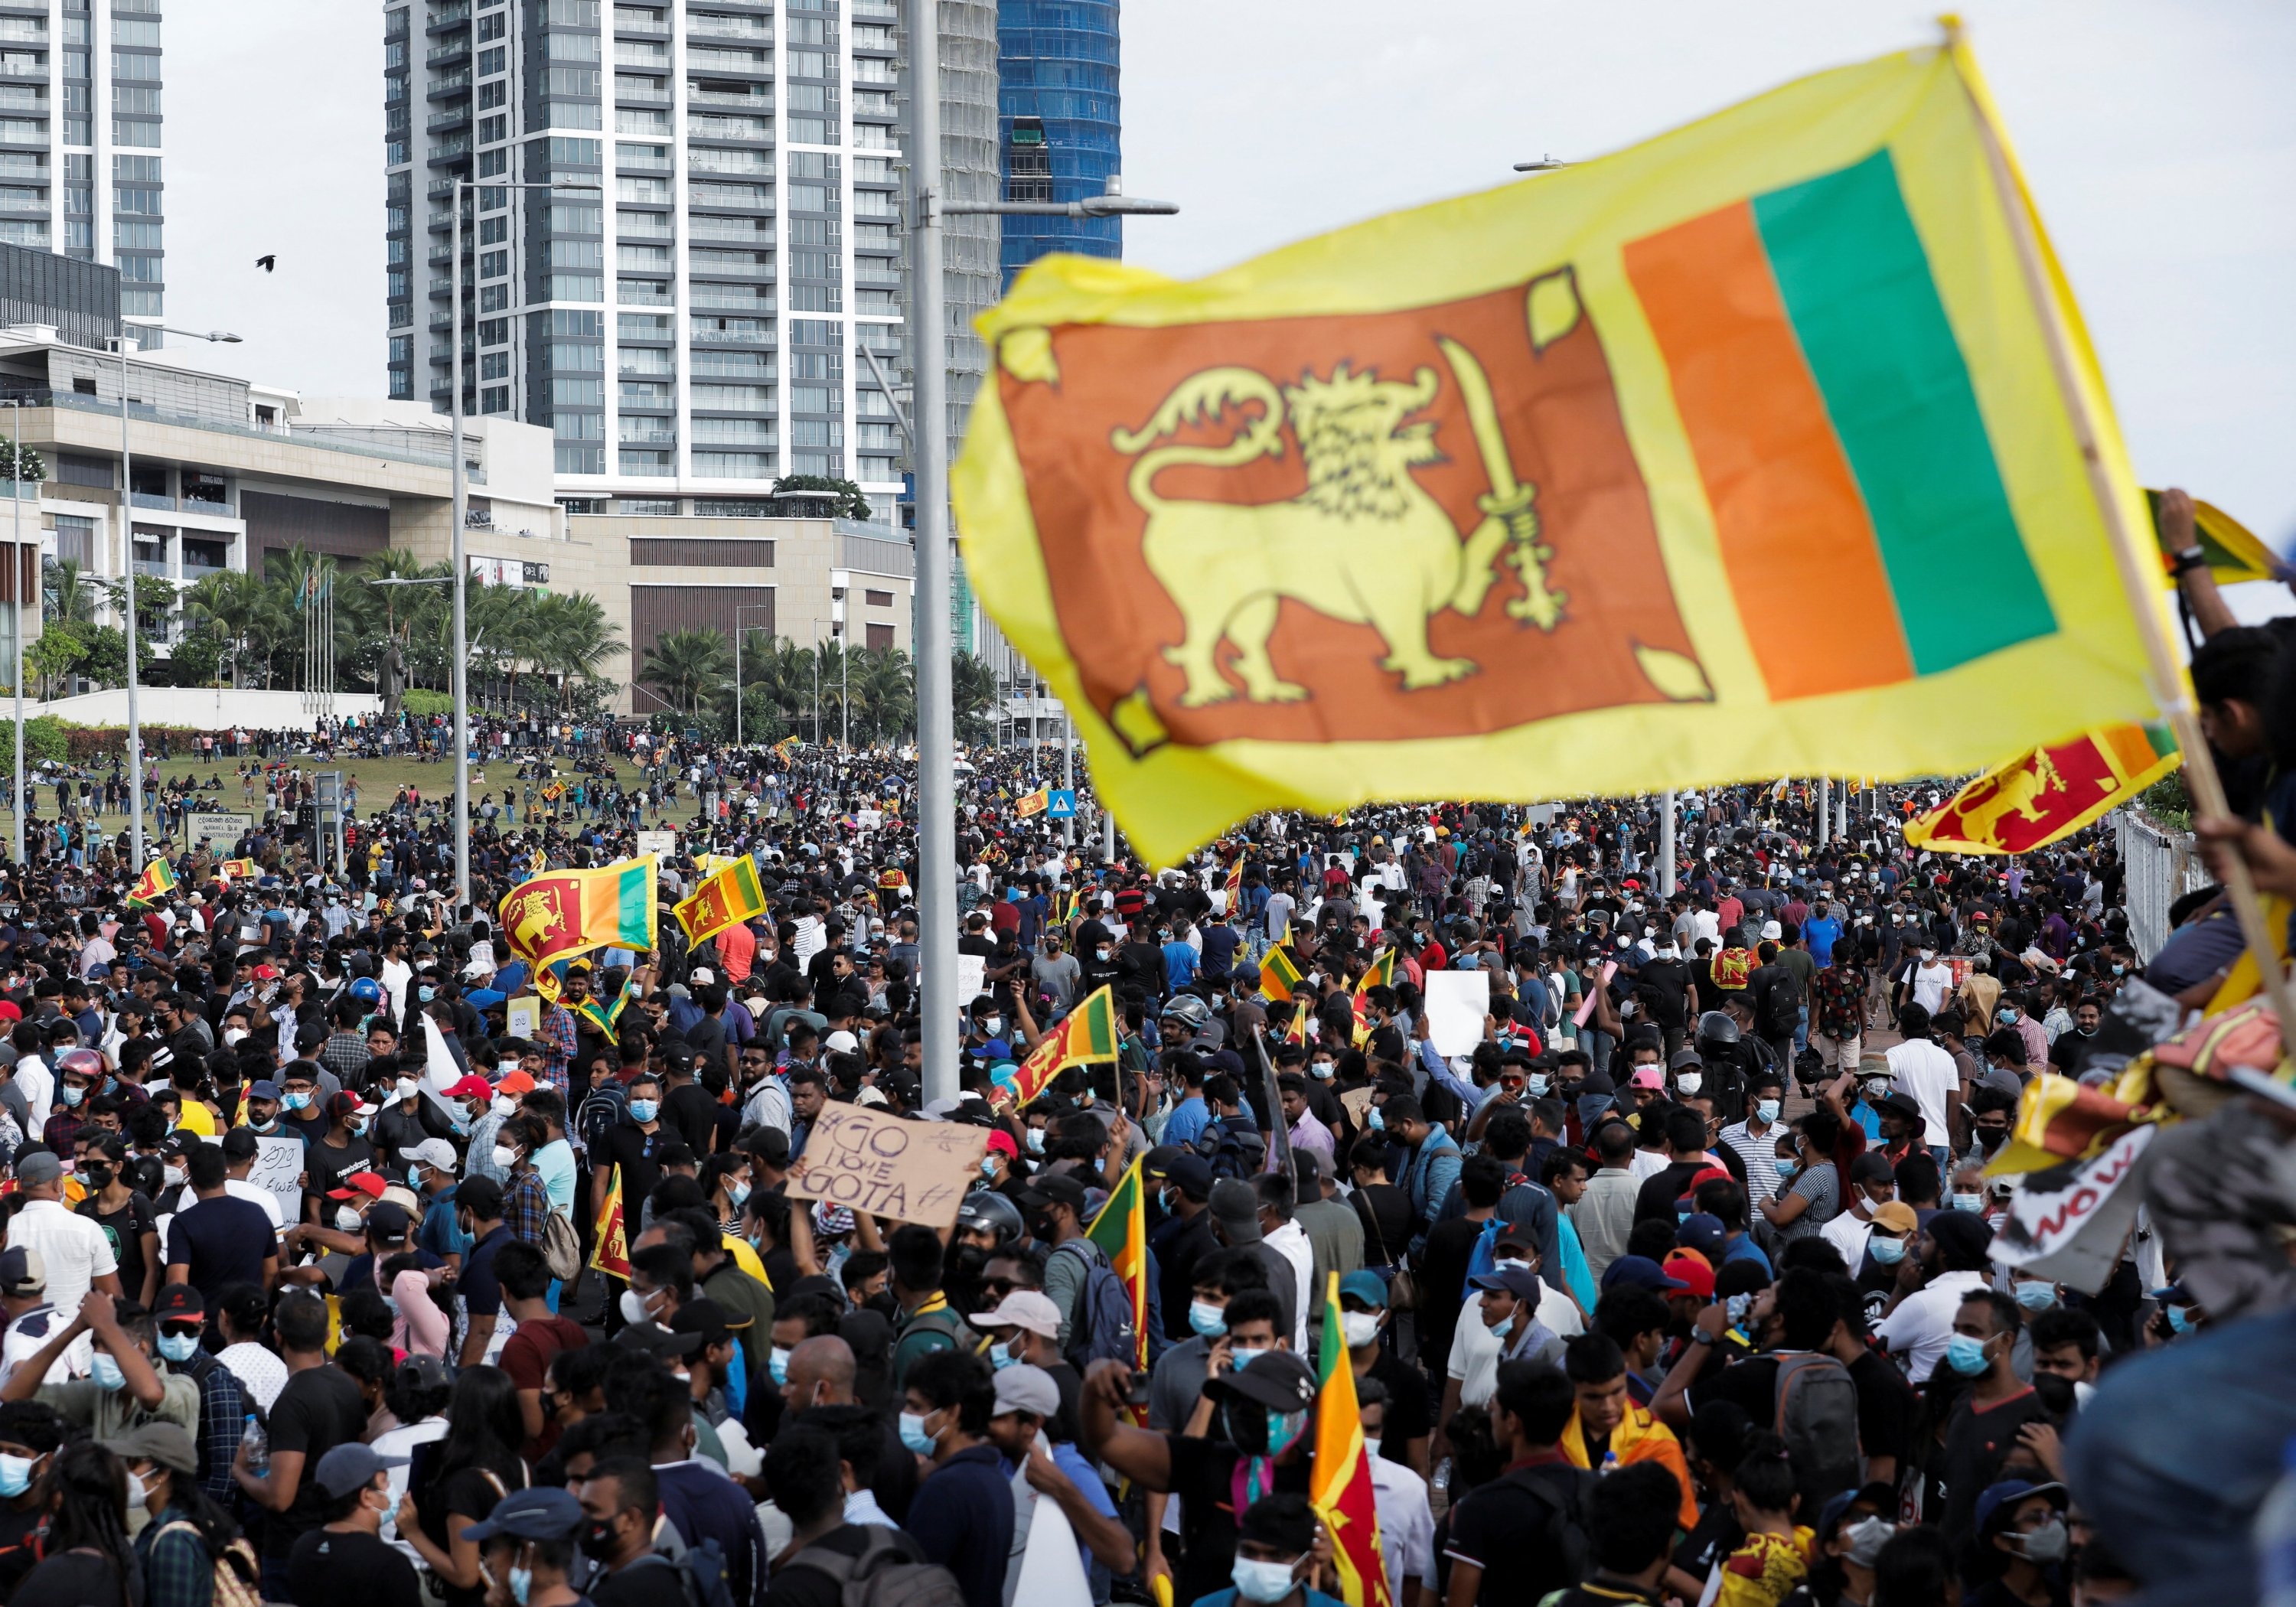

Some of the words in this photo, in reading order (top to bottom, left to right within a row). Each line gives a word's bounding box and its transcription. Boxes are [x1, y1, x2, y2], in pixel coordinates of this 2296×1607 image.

[817, 1111, 909, 1158] #GO
[824, 1146, 896, 1180] HOME
[801, 1165, 906, 1217] GOTA
